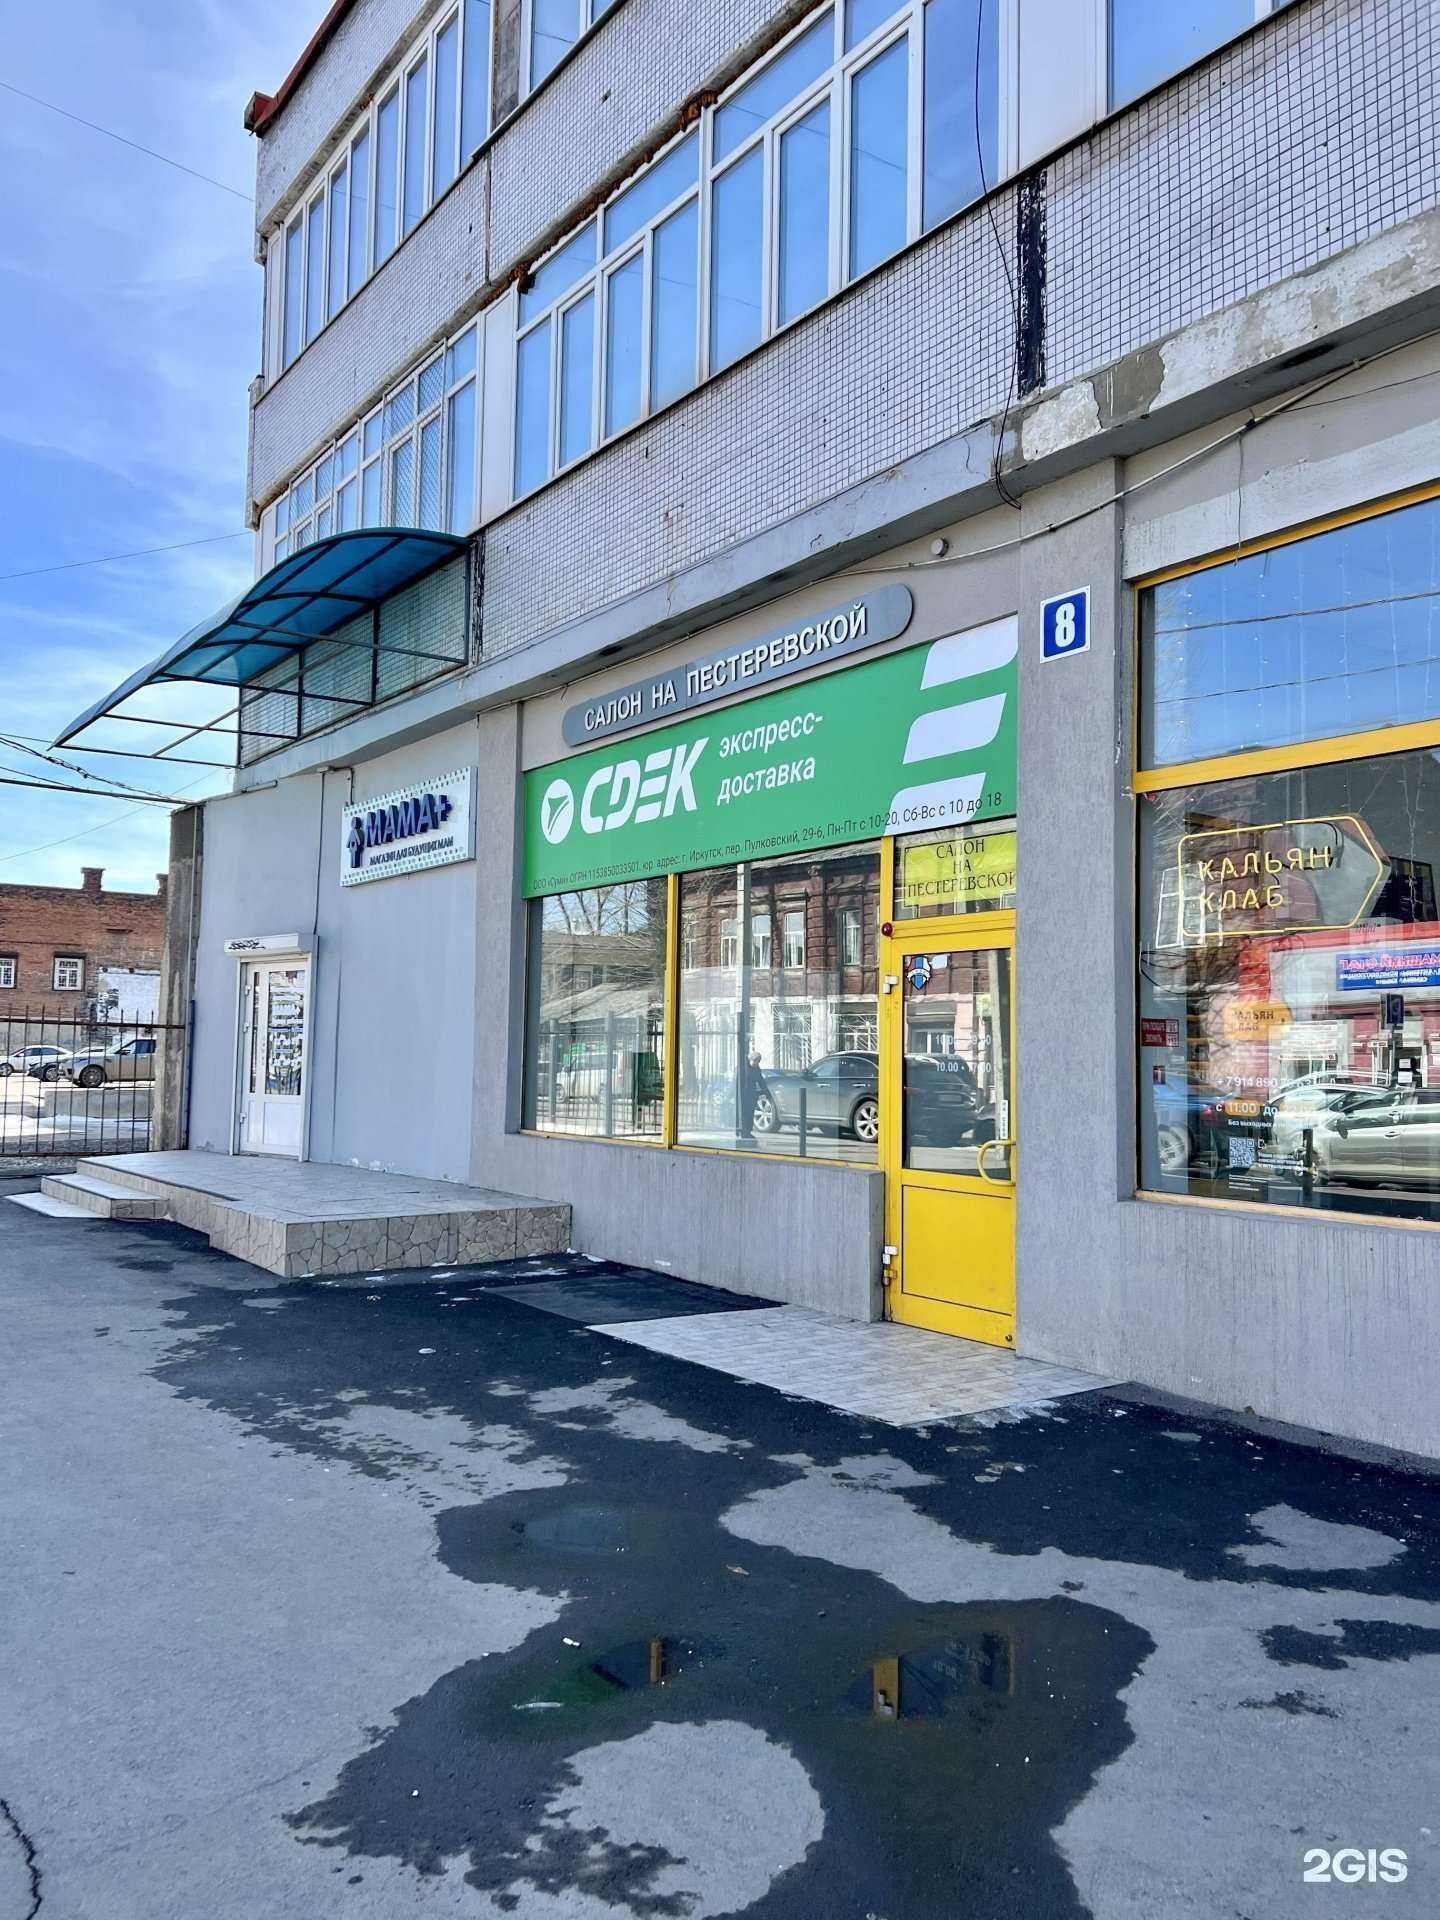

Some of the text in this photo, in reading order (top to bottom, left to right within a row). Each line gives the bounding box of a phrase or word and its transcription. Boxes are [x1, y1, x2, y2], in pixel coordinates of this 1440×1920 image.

[1055, 602, 1076, 648] 8
[584, 602, 868, 732] САЛОН НА ПЕСТЕРЕВСКОЙ
[719, 712, 824, 759] экспресс-
[716, 756, 817, 806] доставка
[744, 831, 800, 854] Пулковский,
[802, 825, 826, 842] 29-6,
[827, 819, 857, 837] Пн-Пт
[859, 819, 866, 831] с
[868, 810, 901, 830] 10-20,
[903, 805, 936, 823] Сб-Вс
[938, 805, 946, 816] с
[950, 798, 964, 814] 10
[966, 797, 983, 814] до
[987, 791, 1003, 807] 18
[936, 838, 985, 859] САЛОН
[1199, 845, 1332, 881] КАЛЬЯН
[953, 858, 972, 875] НА
[1202, 884, 1284, 914] КЛАБ
[1232, 1022, 1260, 1033] ЛАБ
[935, 1061, 959, 1073] 10.00
[1229, 1102, 1257, 1114] 11.00
[1262, 1106, 1279, 1117] до
